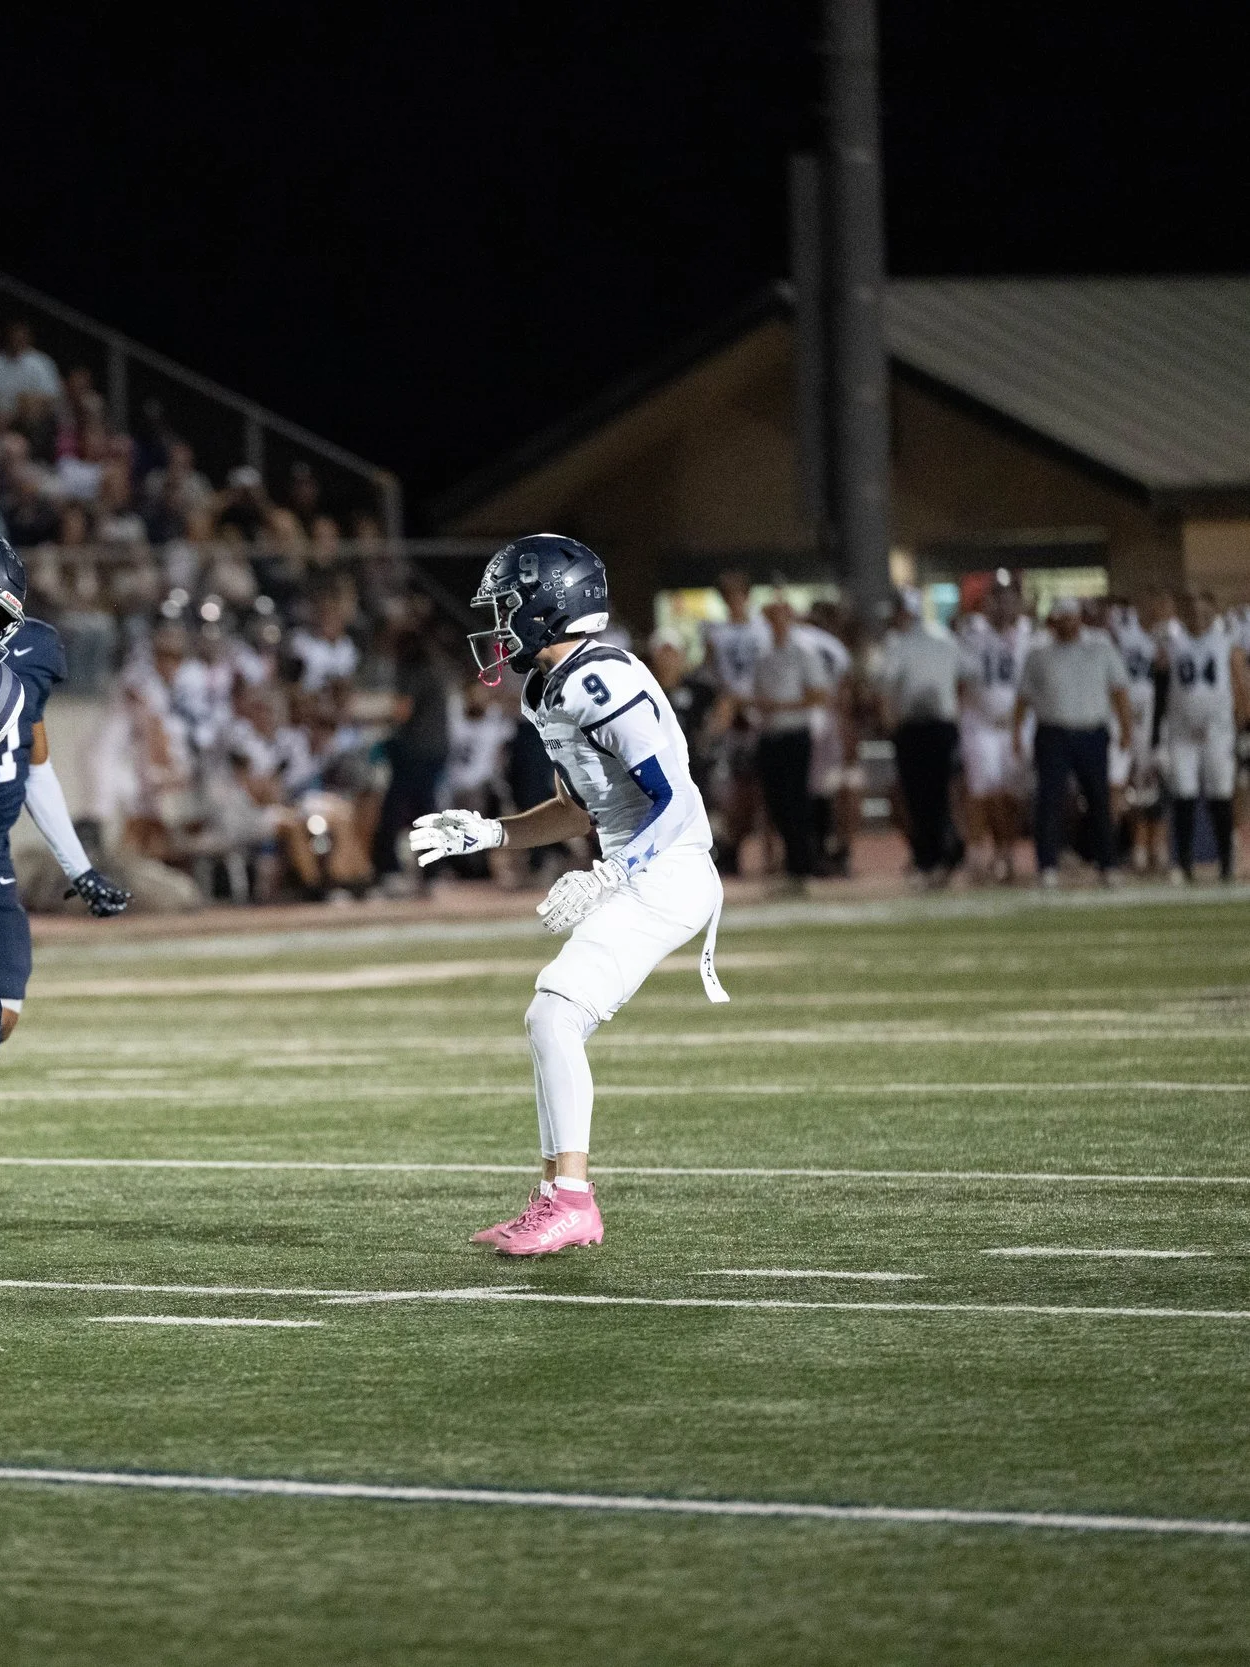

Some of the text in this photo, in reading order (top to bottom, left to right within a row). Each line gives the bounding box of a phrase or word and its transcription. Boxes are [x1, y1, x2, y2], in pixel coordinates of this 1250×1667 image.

[519, 552, 539, 583] 9
[582, 672, 612, 707] 9
[537, 1210, 581, 1246] BATTLE
